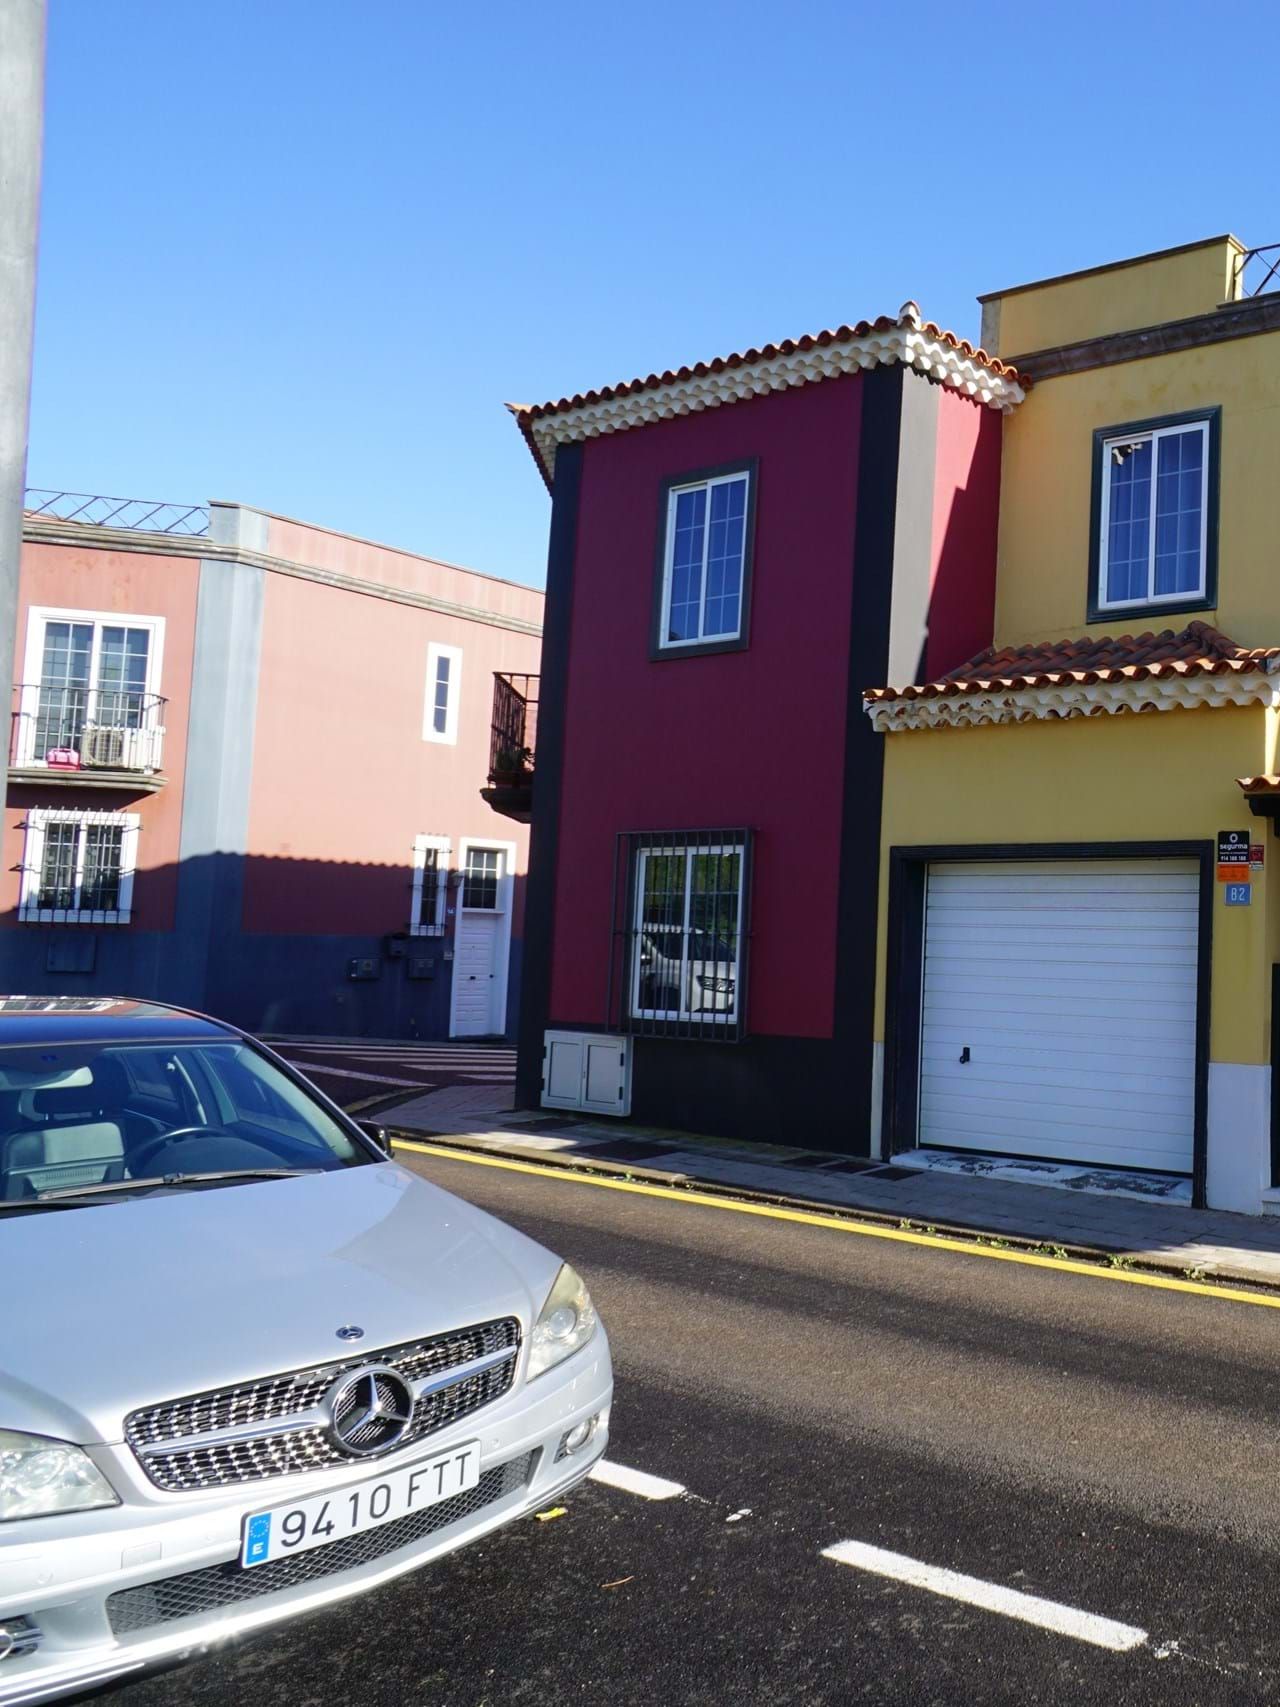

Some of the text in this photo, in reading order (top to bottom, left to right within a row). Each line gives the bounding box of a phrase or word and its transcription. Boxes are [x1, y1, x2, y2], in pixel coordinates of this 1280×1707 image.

[1231, 887, 1245, 901] 82
[280, 1450, 472, 1548] 9410 FTT
[252, 1542, 263, 1555] E
